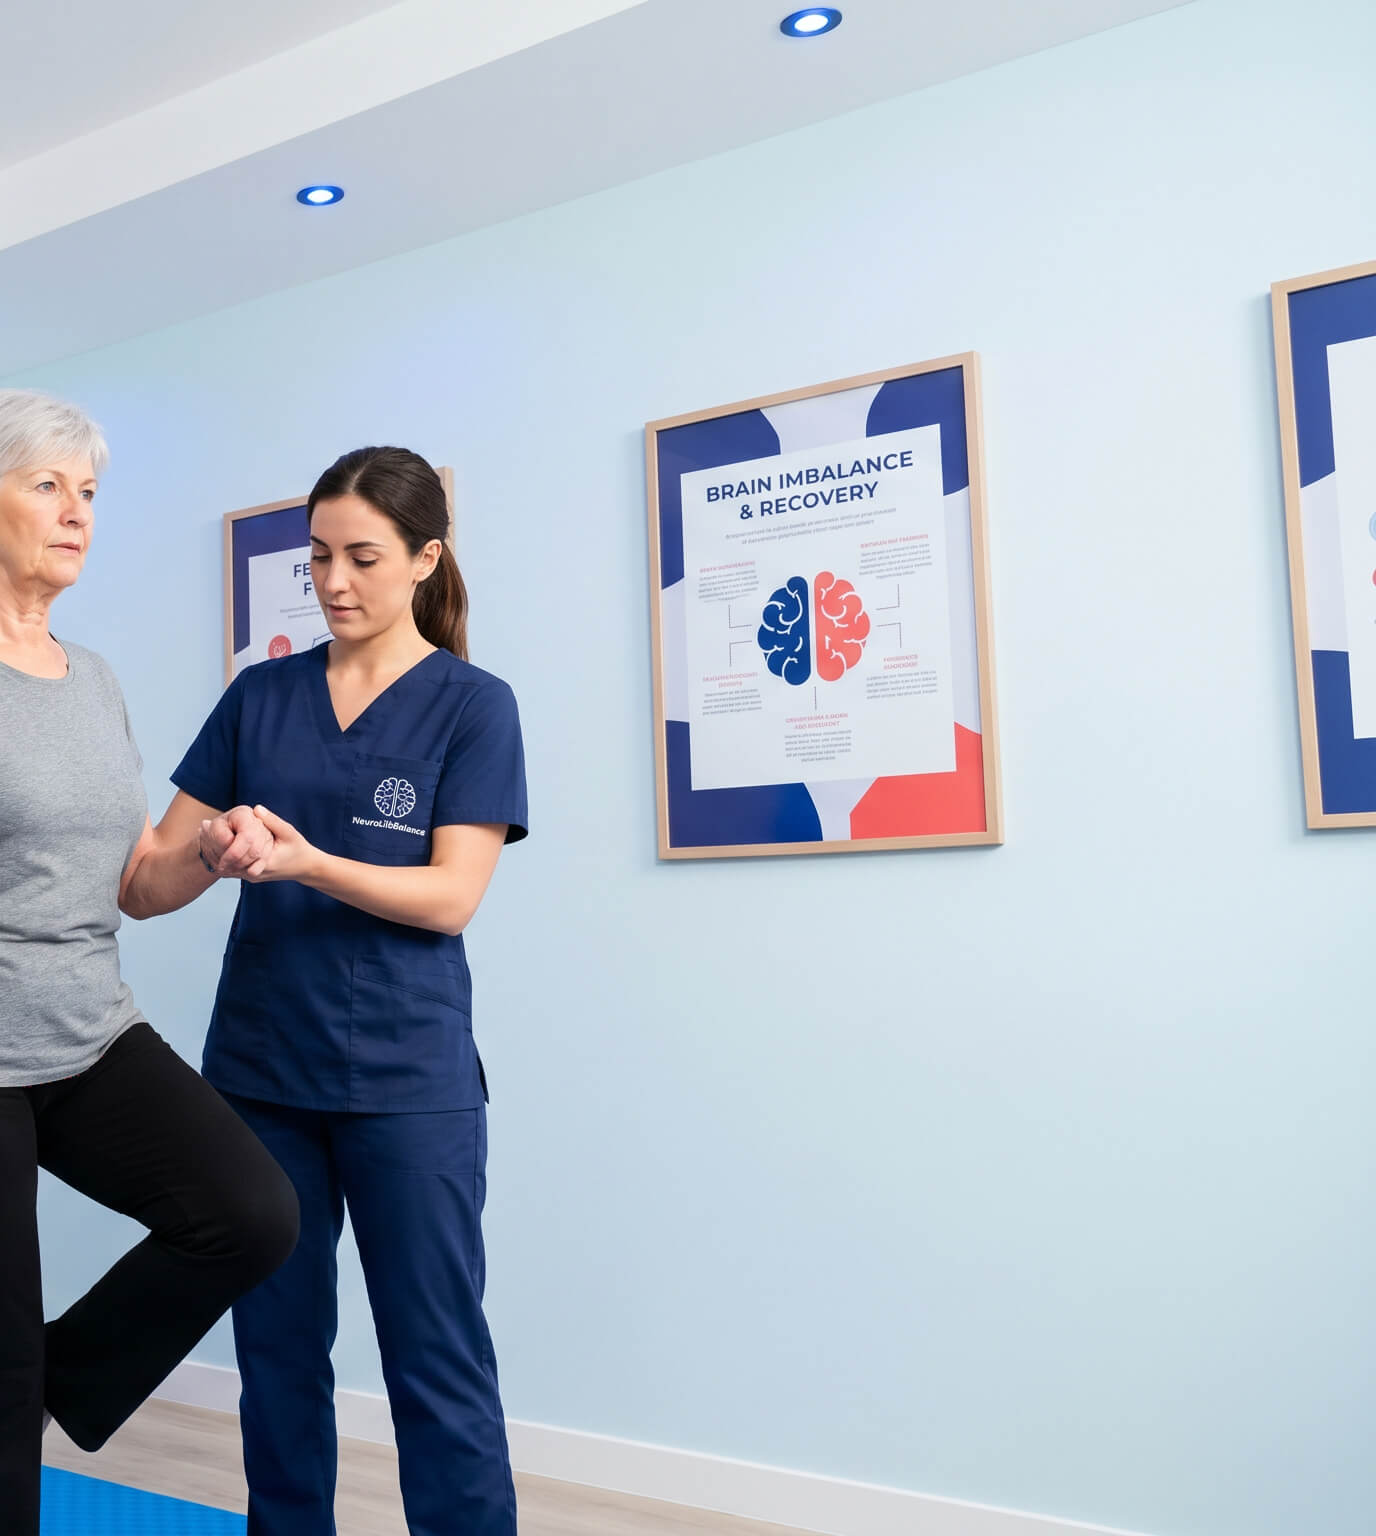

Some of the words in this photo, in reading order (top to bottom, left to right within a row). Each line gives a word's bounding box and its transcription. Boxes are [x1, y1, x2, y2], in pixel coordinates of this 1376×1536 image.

[706, 476, 772, 503] BRAIN
[779, 450, 913, 490] IMBALANCE
[739, 503, 754, 521] &
[760, 480, 879, 517] RECOVERY
